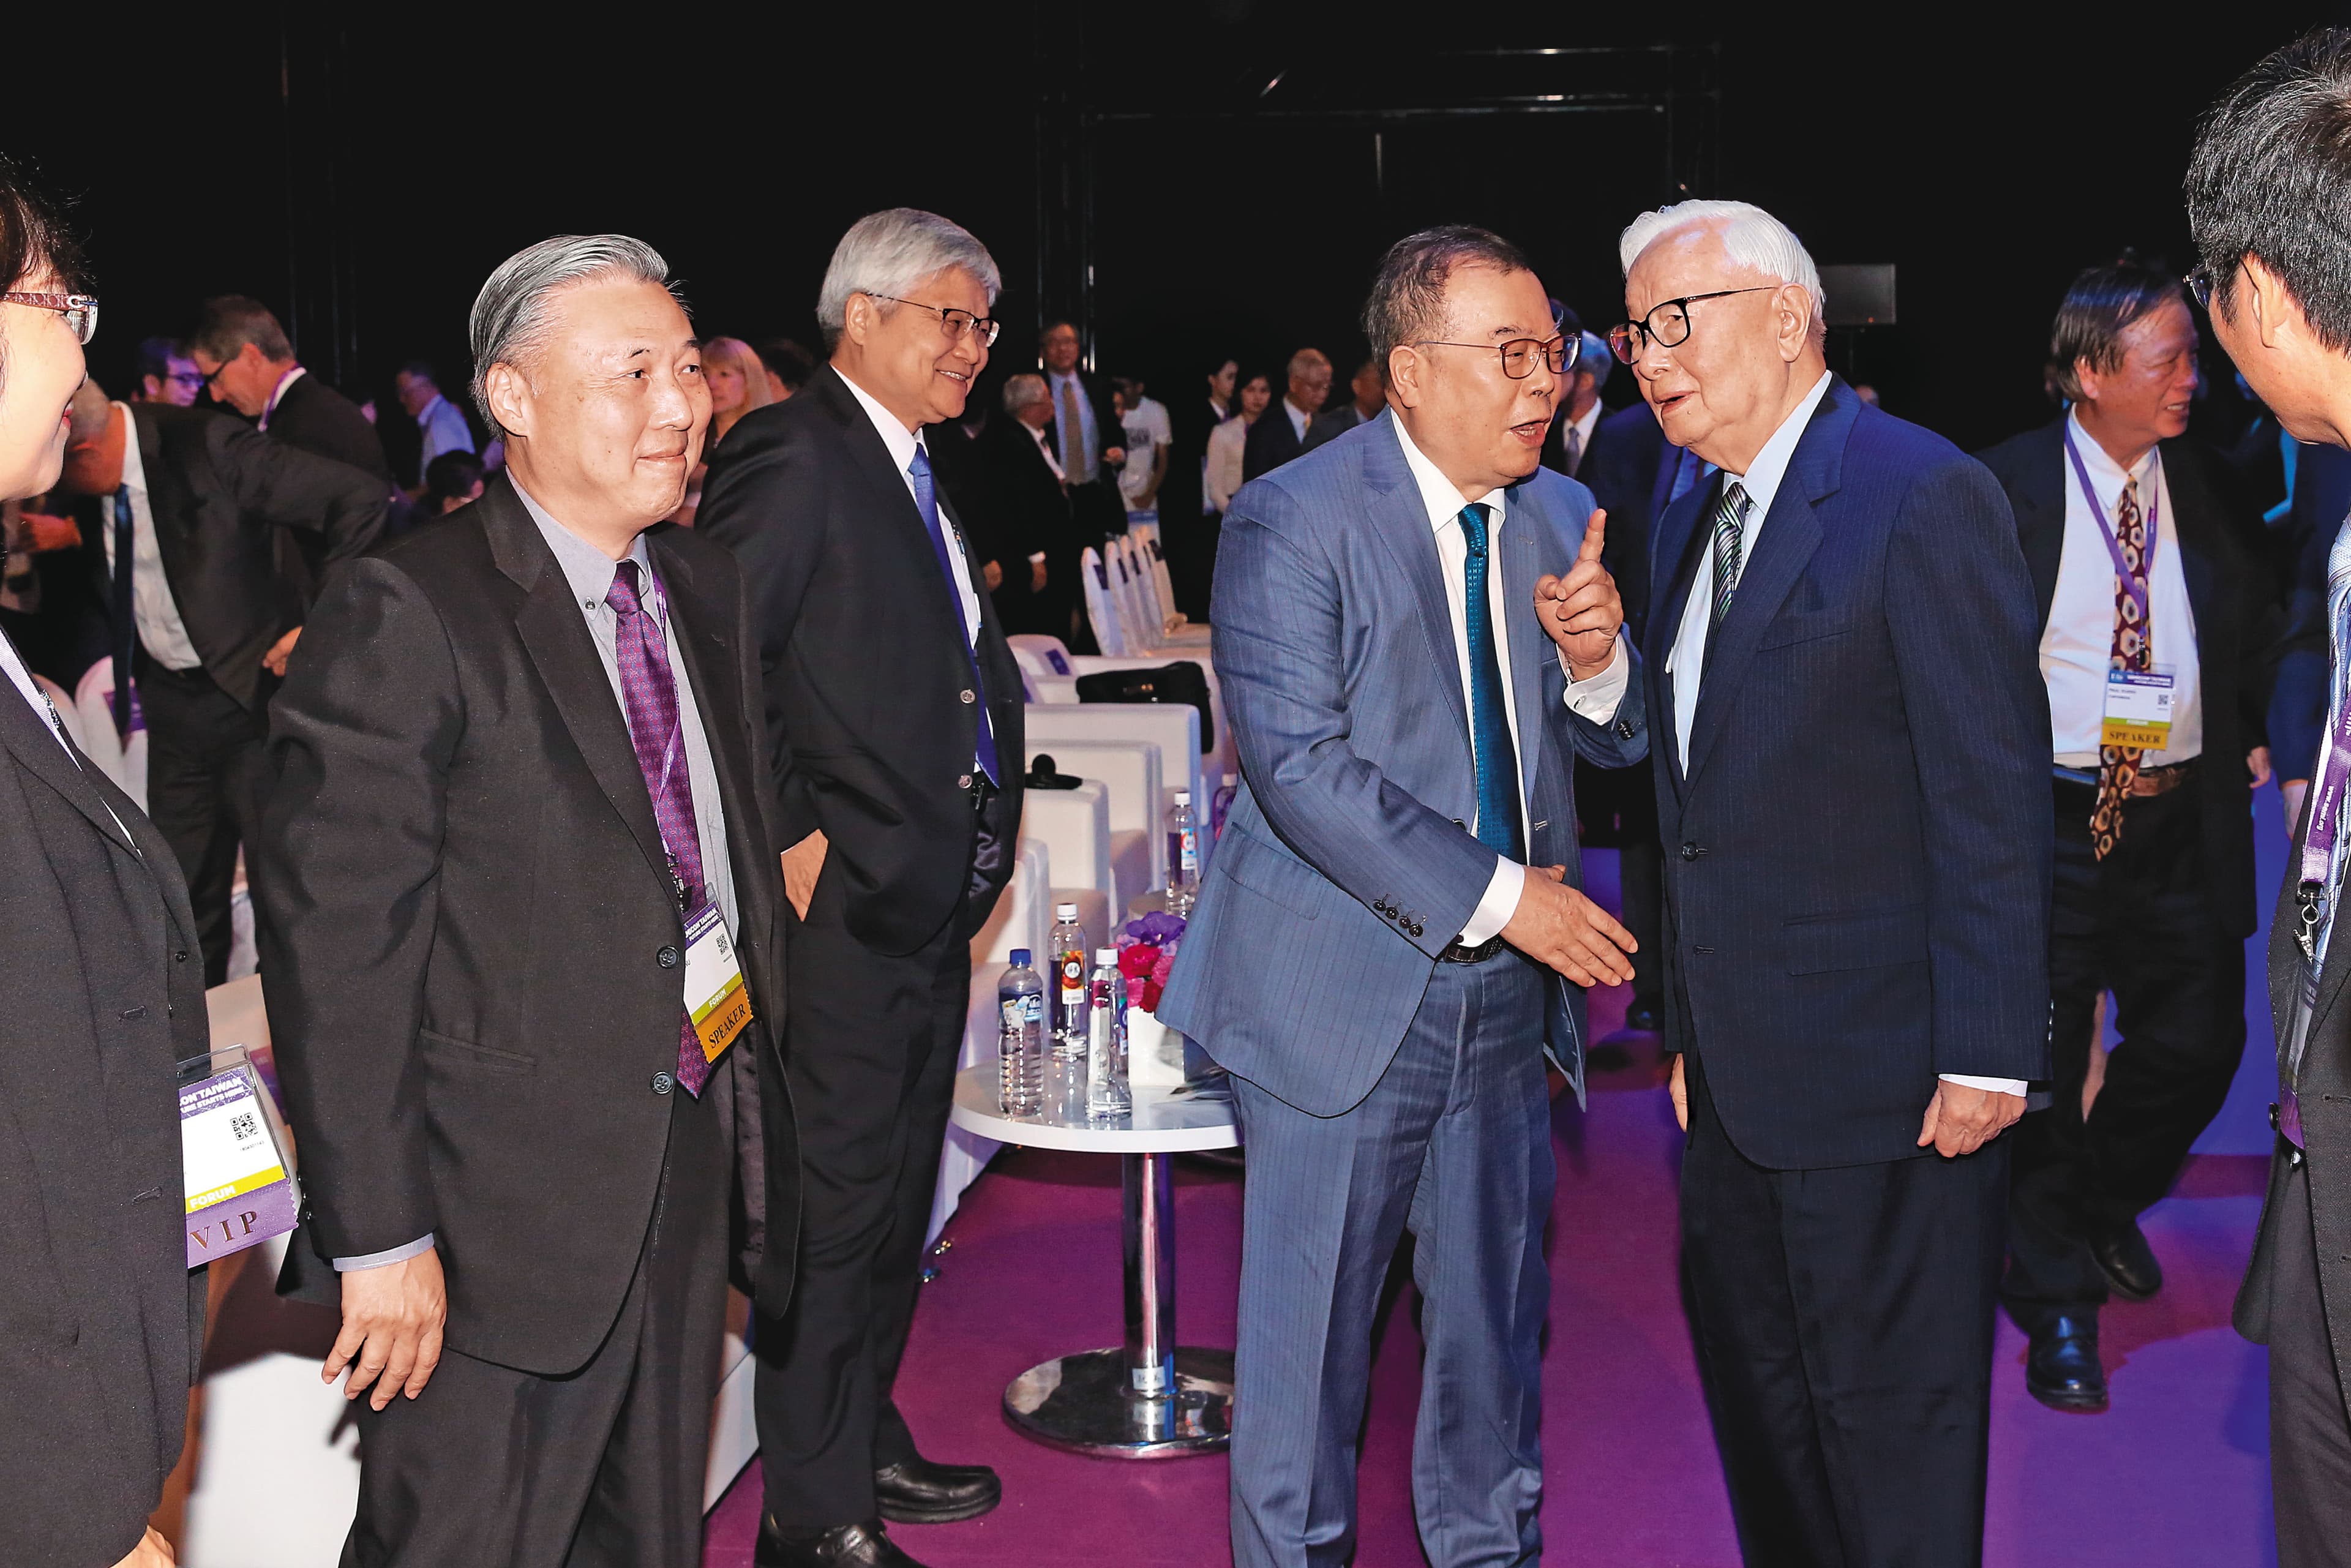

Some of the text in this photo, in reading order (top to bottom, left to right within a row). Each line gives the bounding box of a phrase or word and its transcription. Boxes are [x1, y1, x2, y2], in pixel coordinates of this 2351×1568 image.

[2110, 731, 2161, 744] SPEAKER
[2316, 786, 2334, 831] www.semi.org
[708, 988, 727, 1008] FORUM
[708, 1003, 746, 1049] SPEAKER
[197, 1078, 243, 1099] TAIWAN
[189, 1185, 236, 1209] FORUM
[189, 1210, 257, 1250] VIP
